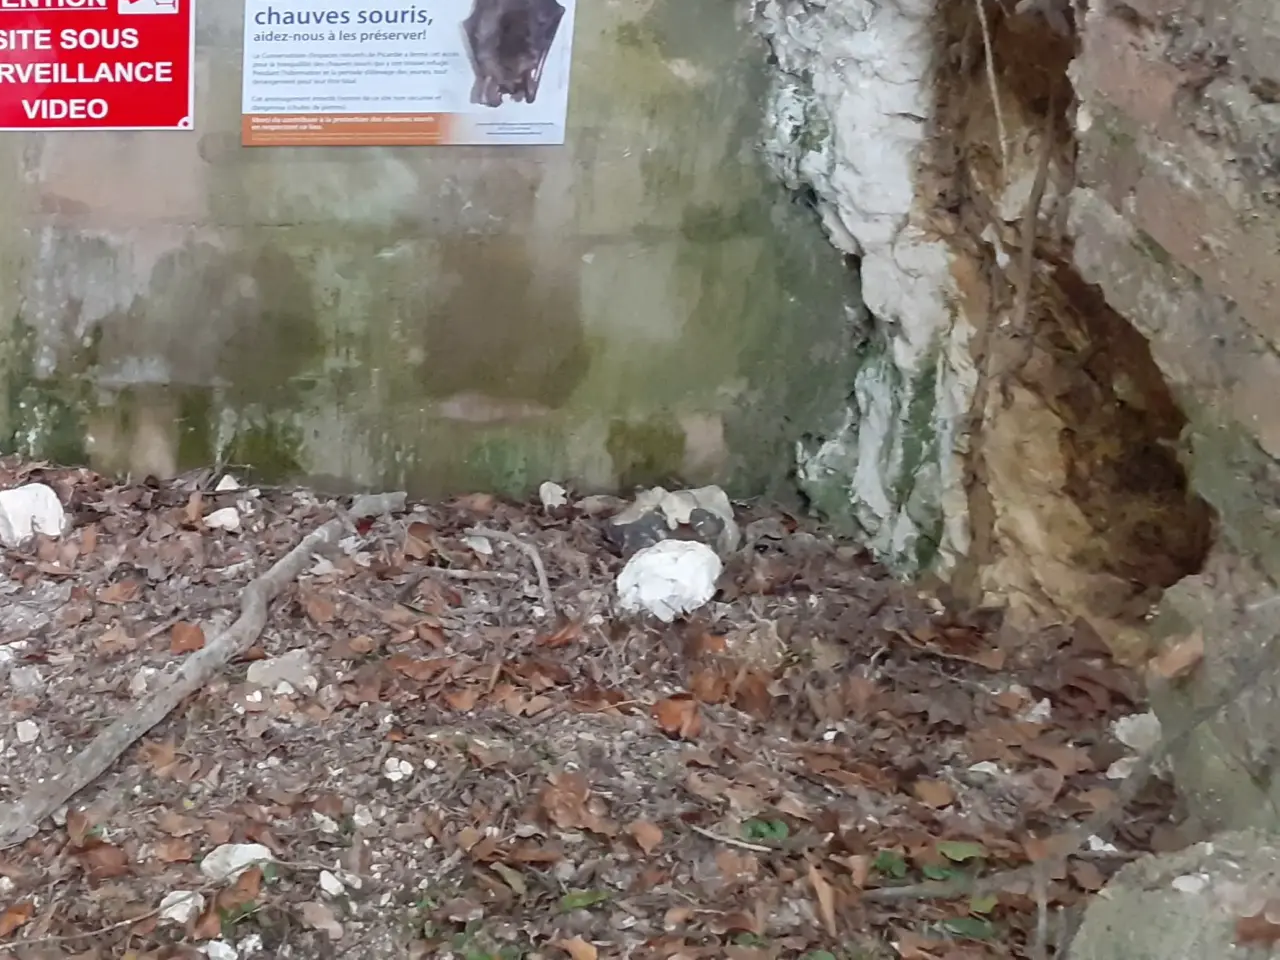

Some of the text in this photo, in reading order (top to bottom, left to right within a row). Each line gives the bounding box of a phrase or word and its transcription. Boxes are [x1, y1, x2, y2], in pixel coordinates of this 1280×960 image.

[254, 5, 433, 26] chauves souris,
[59, 28, 139, 50] SOUS
[253, 30, 427, 43] aidez-nous à les préserver!
[21, 98, 109, 120] VIDEO
